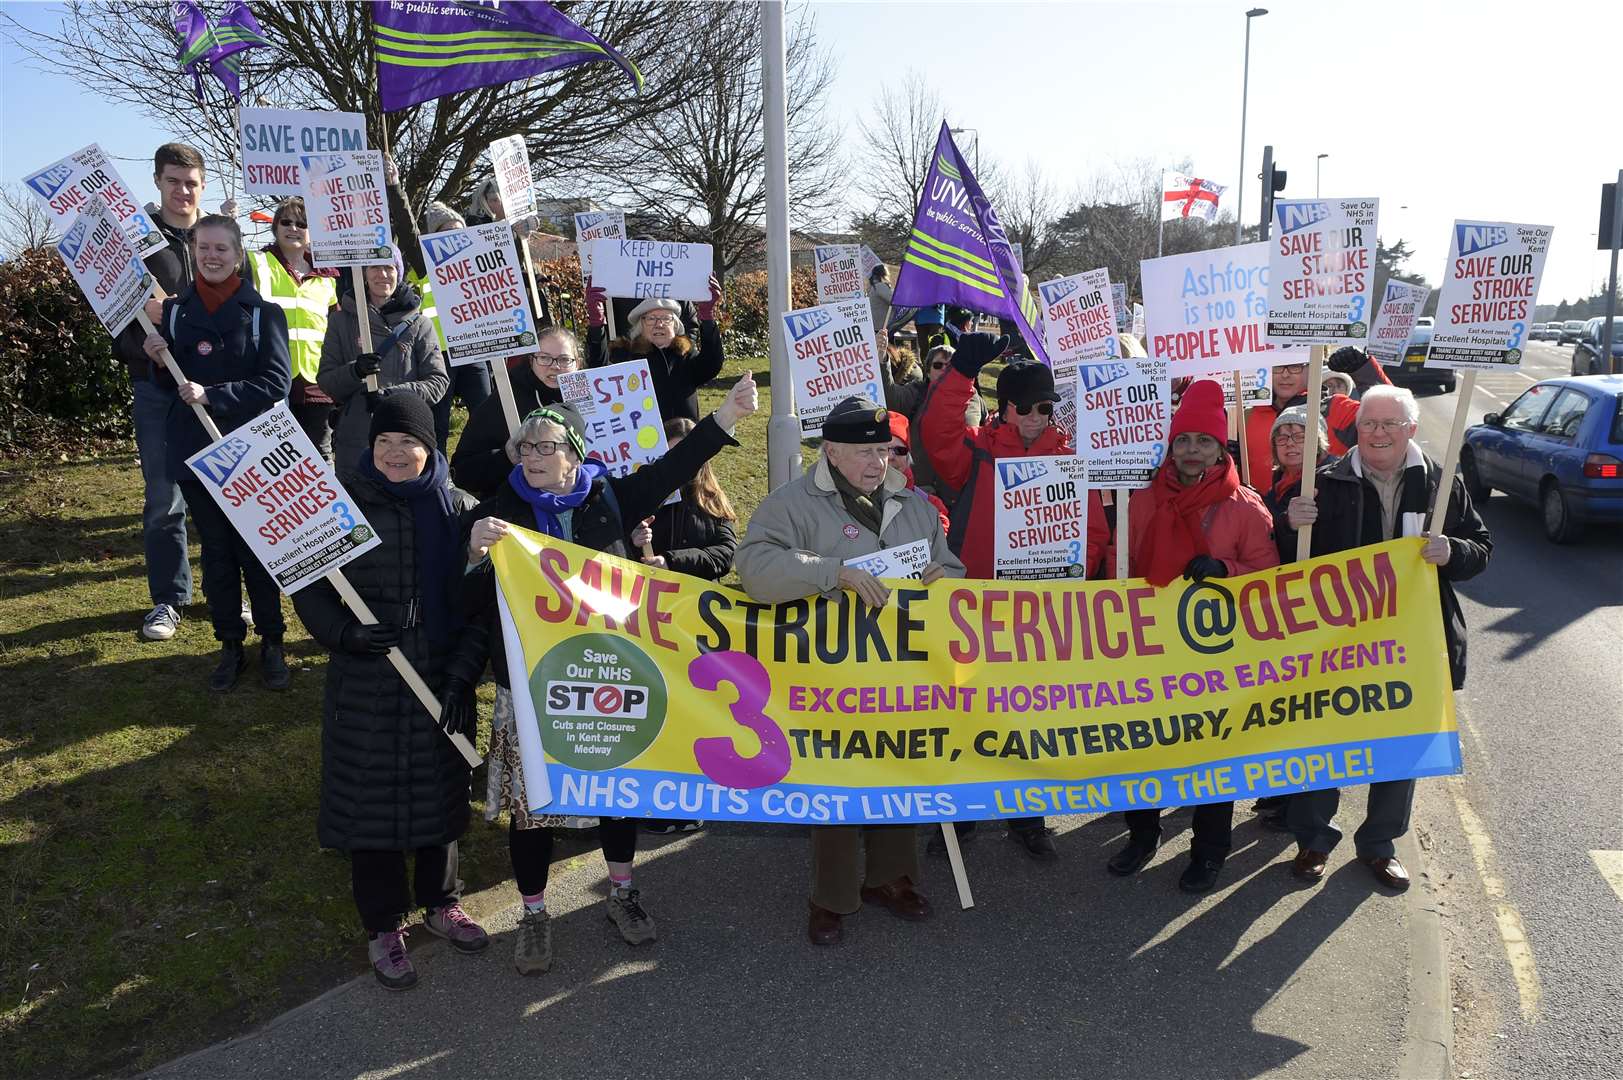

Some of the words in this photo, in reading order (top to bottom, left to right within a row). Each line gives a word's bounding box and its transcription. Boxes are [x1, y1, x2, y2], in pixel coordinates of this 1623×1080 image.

[390, 0, 404, 11] the
[406, 3, 439, 14] public
[441, 7, 475, 17] service
[244, 124, 295, 153] SAVE
[247, 164, 300, 186] STROKE
[347, 174, 374, 191] OUR
[50, 186, 86, 215] SAVE
[80, 170, 110, 195] OUR
[936, 212, 958, 226] public
[1282, 203, 1330, 231] NHS
[1340, 202, 1358, 211] Save
[1360, 202, 1375, 211] Our
[1346, 210, 1364, 219] NHS
[1366, 210, 1374, 219] in
[582, 229, 601, 242] SAVE
[604, 224, 620, 239] OUR
[1355, 218, 1373, 227] Kent
[1517, 228, 1534, 236] Save
[1535, 229, 1549, 237] Our
[74, 241, 97, 274] SAVE
[92, 218, 112, 246] OUR
[374, 226, 386, 246] 3
[431, 232, 473, 265] NHS
[1280, 231, 1322, 257] SAVE
[1462, 225, 1508, 254] NHS
[1521, 237, 1538, 245] NHS
[1528, 245, 1545, 253] Kent
[94, 227, 124, 275] STROKE
[620, 240, 655, 257] KEEP
[660, 243, 689, 259] OUR
[95, 243, 133, 300] SERVICES
[131, 257, 143, 278] 3
[435, 259, 475, 286] SAVE
[475, 249, 507, 273] OUR
[636, 259, 673, 277] NHS
[819, 262, 838, 275] SAVE
[839, 258, 856, 271] OUR
[830, 269, 860, 284] STROKE
[1455, 256, 1497, 279] SAVE
[1500, 254, 1533, 276] OUR
[460, 268, 519, 300] STROKE
[634, 282, 671, 299] FREE
[823, 281, 860, 296] SERVICES
[1046, 281, 1078, 304] NHS
[1473, 276, 1535, 300] STROKE
[450, 289, 522, 324] SERVICES
[1049, 299, 1079, 321] SAVE
[1080, 291, 1103, 310] OUR
[1066, 304, 1111, 331] STROKE
[1184, 302, 1200, 326] is
[1207, 299, 1236, 322] too
[1244, 291, 1267, 318] fa
[1269, 310, 1306, 319] Excellent
[1308, 310, 1348, 321] Hospitals
[1348, 295, 1365, 322] 3
[1383, 303, 1401, 315] SAVE
[1402, 302, 1416, 314] OUR
[1451, 300, 1528, 325] SERVICES
[513, 309, 526, 333] 3
[790, 310, 832, 338] NHS
[1376, 327, 1409, 339] SERVICES
[1389, 314, 1413, 327] STROKE
[447, 332, 480, 343] Excellent
[481, 325, 514, 337] Hospitals
[794, 334, 832, 361] SAVE
[833, 325, 864, 348] OUR
[1058, 321, 1112, 351] SERVICES
[1105, 337, 1115, 356] 3
[1154, 328, 1220, 362] PEOPLE
[1433, 333, 1469, 343] Excellent
[1471, 335, 1506, 346] Hospitals
[1506, 322, 1525, 349] 3
[817, 342, 874, 374] STROKE
[594, 369, 648, 404] STOP
[806, 363, 875, 398] SERVICES
[1086, 363, 1129, 388] NHS
[1084, 388, 1124, 411] SAVE
[1127, 383, 1158, 403] OUR
[1106, 402, 1165, 427] STROKE
[1090, 423, 1163, 450] SERVICES
[198, 437, 251, 485] NHS
[1151, 443, 1163, 467] 3
[222, 466, 268, 507] SAVE
[261, 441, 303, 477] OUR
[256, 457, 325, 515] STROKE
[1005, 461, 1048, 487] NHS
[1003, 487, 1042, 510] SAVE
[1046, 481, 1076, 502] OUR
[258, 480, 338, 546] SERVICES
[332, 502, 356, 530] 3
[1024, 500, 1082, 527] STROKE
[1008, 520, 1080, 549] SERVICES
[267, 548, 302, 570] Excellent
[303, 526, 341, 552] Hospitals
[997, 558, 1031, 567] Excellent
[1033, 555, 1067, 566] Hospitals
[1067, 541, 1081, 564] 3
[535, 547, 680, 651] SAVE
[696, 588, 929, 664] STROKE
[949, 587, 1164, 664] SERVICE
[1177, 551, 1397, 655] @QEQM
[583, 649, 618, 664] Save
[566, 663, 594, 680] Our
[597, 665, 631, 682] NHS
[789, 684, 977, 714] EXCELLENT
[987, 677, 1154, 713] HOSPITALS
[1160, 669, 1226, 700] FOR
[1235, 653, 1314, 688] EAST
[1320, 640, 1407, 674] KENT:
[548, 684, 645, 715] STOP
[552, 720, 575, 731] Cuts
[576, 721, 595, 731] and
[597, 721, 637, 733] Closures
[688, 650, 791, 789] 3
[789, 728, 962, 762] THANET,
[973, 707, 1232, 761] CANTERBURY,
[1241, 680, 1413, 731] ASHFORD
[567, 733, 576, 743] in
[579, 733, 601, 744] Kent
[603, 734, 621, 744] and
[574, 743, 612, 757] Medway
[560, 773, 641, 809] NHS
[653, 780, 749, 813] CUTS
[762, 788, 849, 821] COST
[860, 791, 957, 820] LIVES
[994, 780, 1111, 814] LISTEN
[1120, 777, 1163, 806] TO
[1172, 766, 1237, 802] THE
[1244, 746, 1374, 792] PEOPLE!
